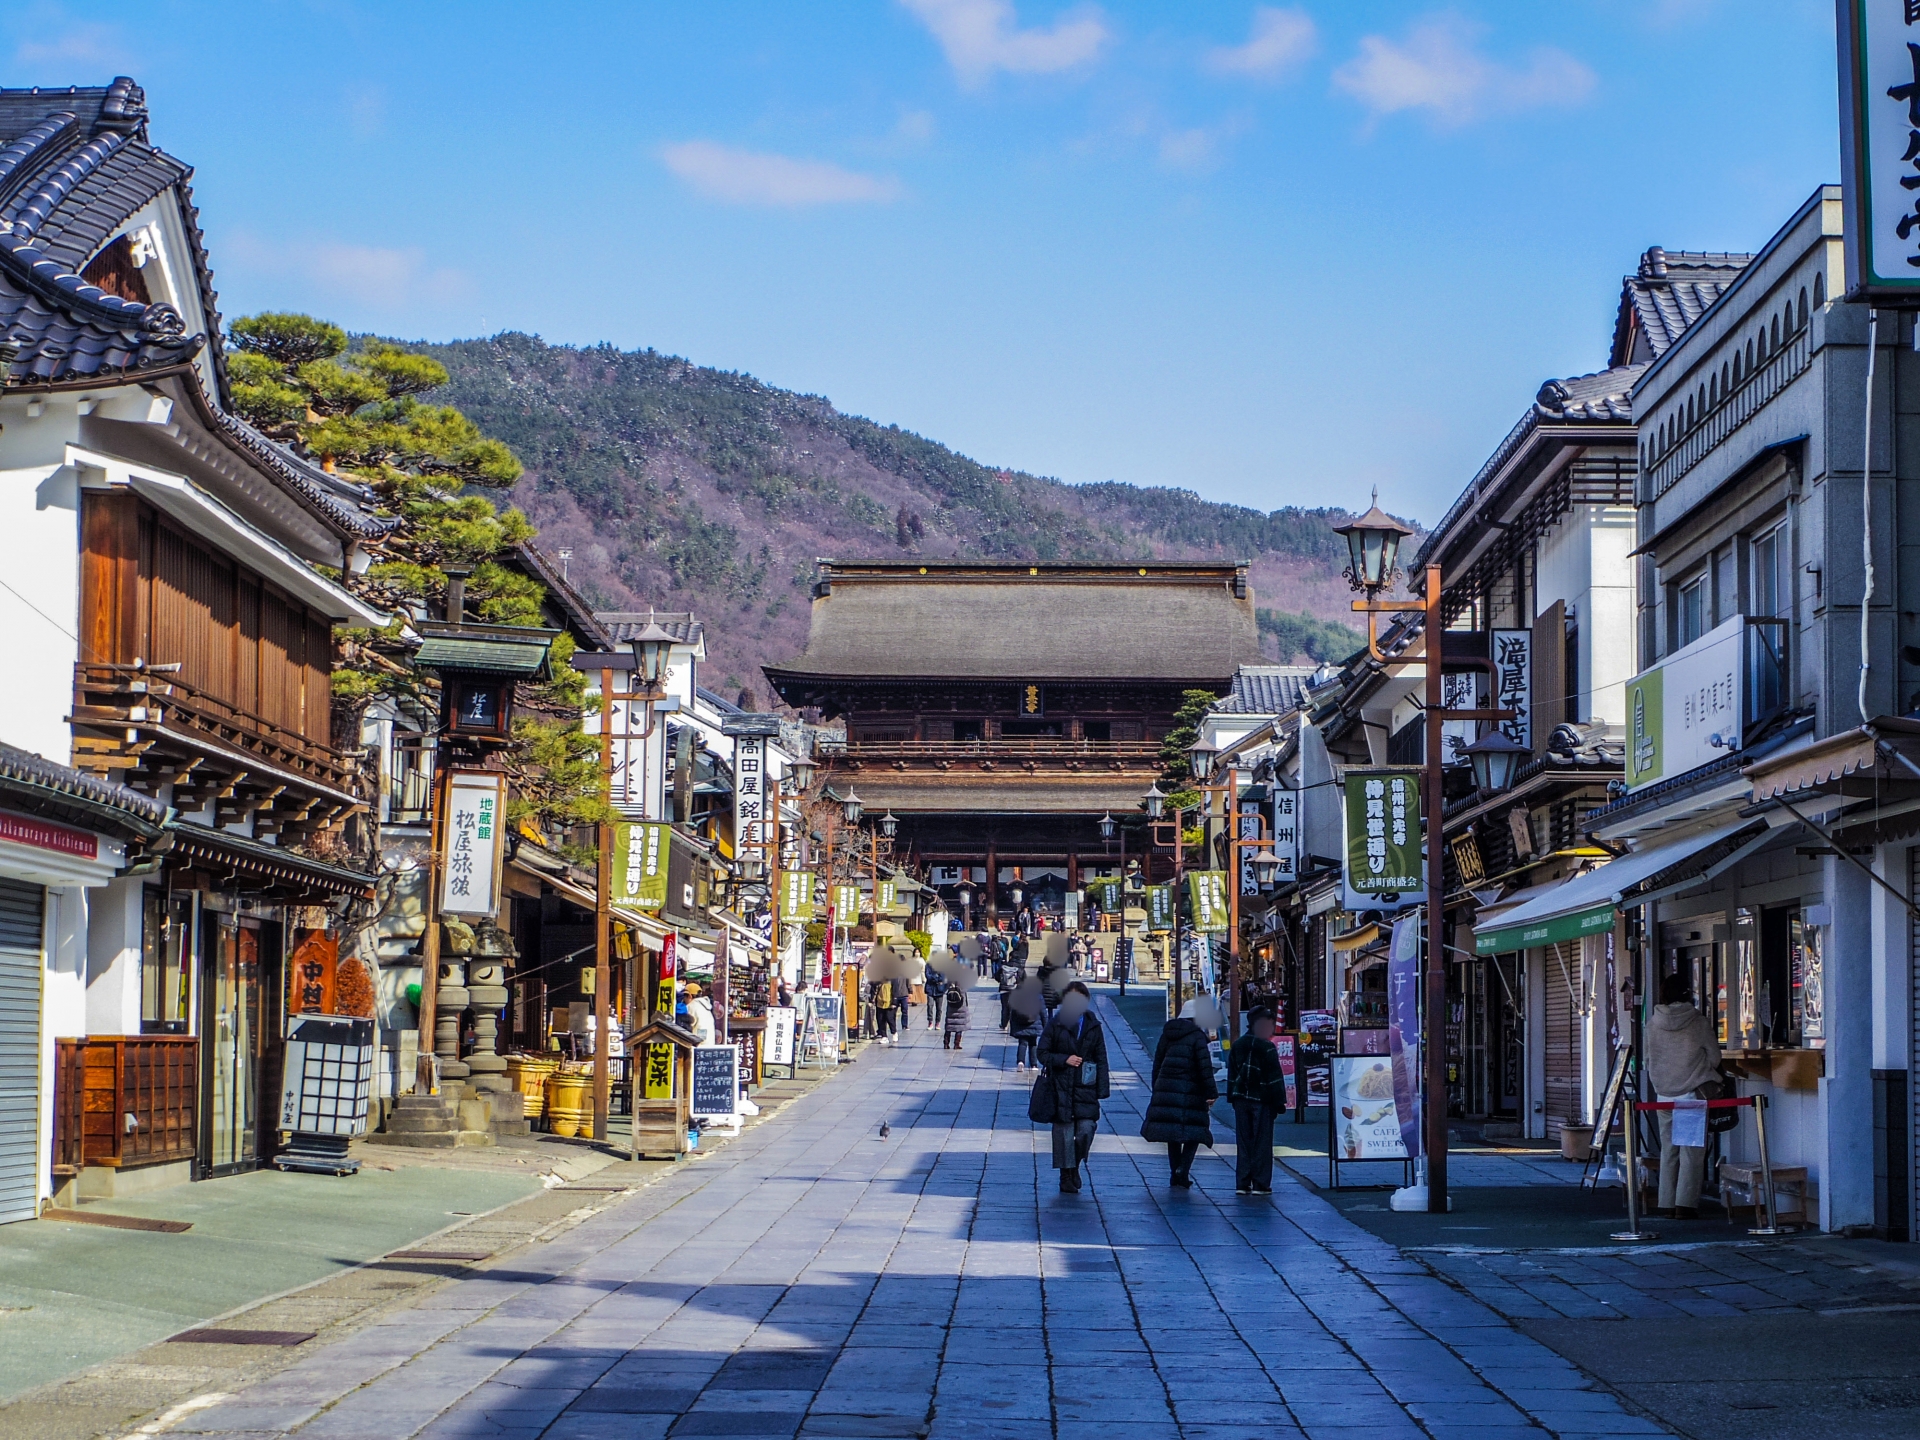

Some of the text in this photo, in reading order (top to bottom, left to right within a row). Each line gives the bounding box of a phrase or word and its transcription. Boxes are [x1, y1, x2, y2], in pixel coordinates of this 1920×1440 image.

[470, 691, 487, 720] 松屋
[1497, 636, 1528, 746] 滝屋本店
[477, 797, 493, 840] 地蔵館
[739, 736, 761, 866] 高田屋銘産
[1390, 779, 1407, 846] 信州善光寺
[53, 831, 93, 853] Kichiemon
[1277, 797, 1294, 874] 信州屋
[1365, 779, 1387, 875] 仲見世通り
[1356, 876, 1418, 888] 元善町商盛会
[302, 960, 325, 1014] 中村
[282, 1091, 295, 1124] 中村屋
[1367, 1139, 1405, 1148] SWEETS
[1373, 1128, 1398, 1136] CAFE
